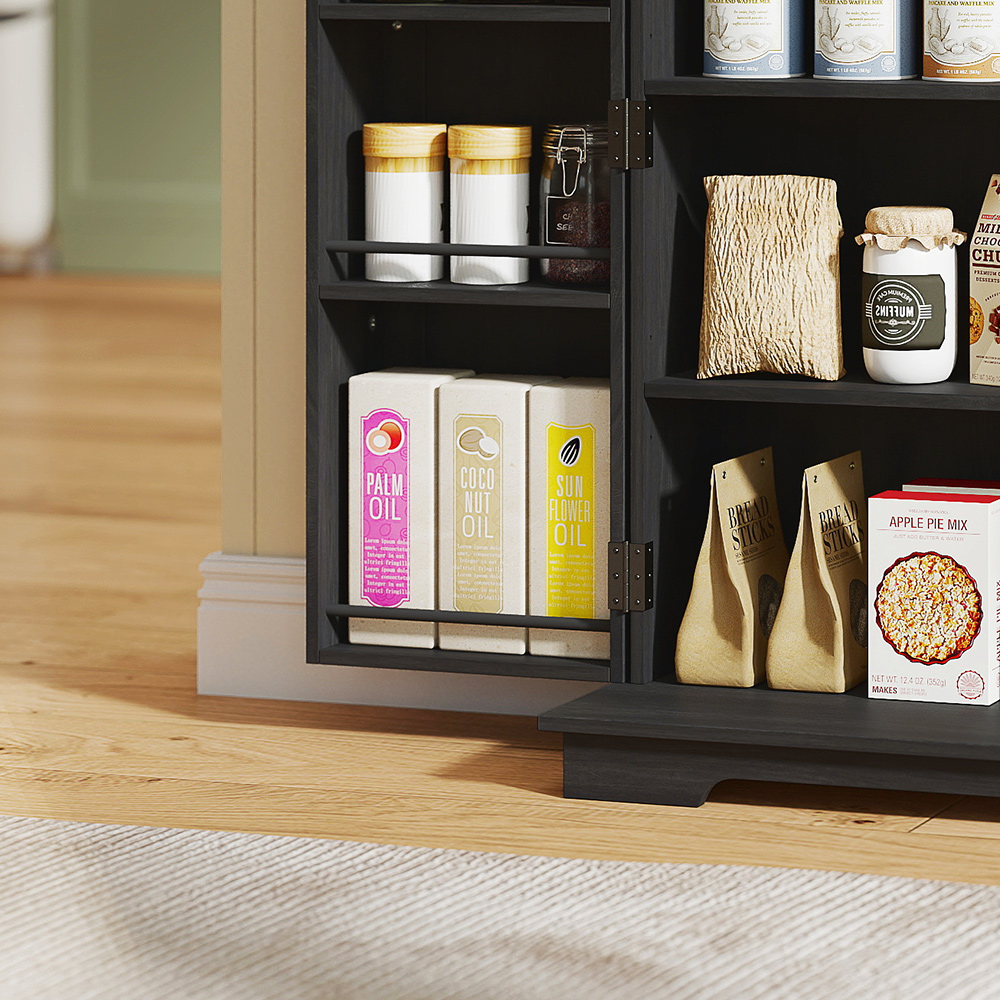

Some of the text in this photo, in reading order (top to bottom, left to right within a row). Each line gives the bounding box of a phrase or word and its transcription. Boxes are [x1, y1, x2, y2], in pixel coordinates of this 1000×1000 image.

[366, 472, 403, 496] PALM
[460, 467, 495, 490] COCO
[556, 474, 583, 498] SUN
[369, 497, 401, 520] OIL
[465, 491, 490, 514] NUT
[549, 498, 591, 522] FLOWER
[727, 495, 769, 529] BREAD
[462, 515, 494, 538] OIL
[818, 499, 858, 534] BREAD
[889, 516, 968, 530] APPLE PIE MIX
[554, 523, 587, 547] OIL
[731, 515, 776, 550] STICKS
[823, 520, 865, 555] STICKS
[871, 675, 884, 683] NET
[886, 675, 898, 683] WT.
[900, 676, 913, 685] 12.4
[926, 678, 947, 687] (352g)
[872, 685, 898, 694] MAKES
